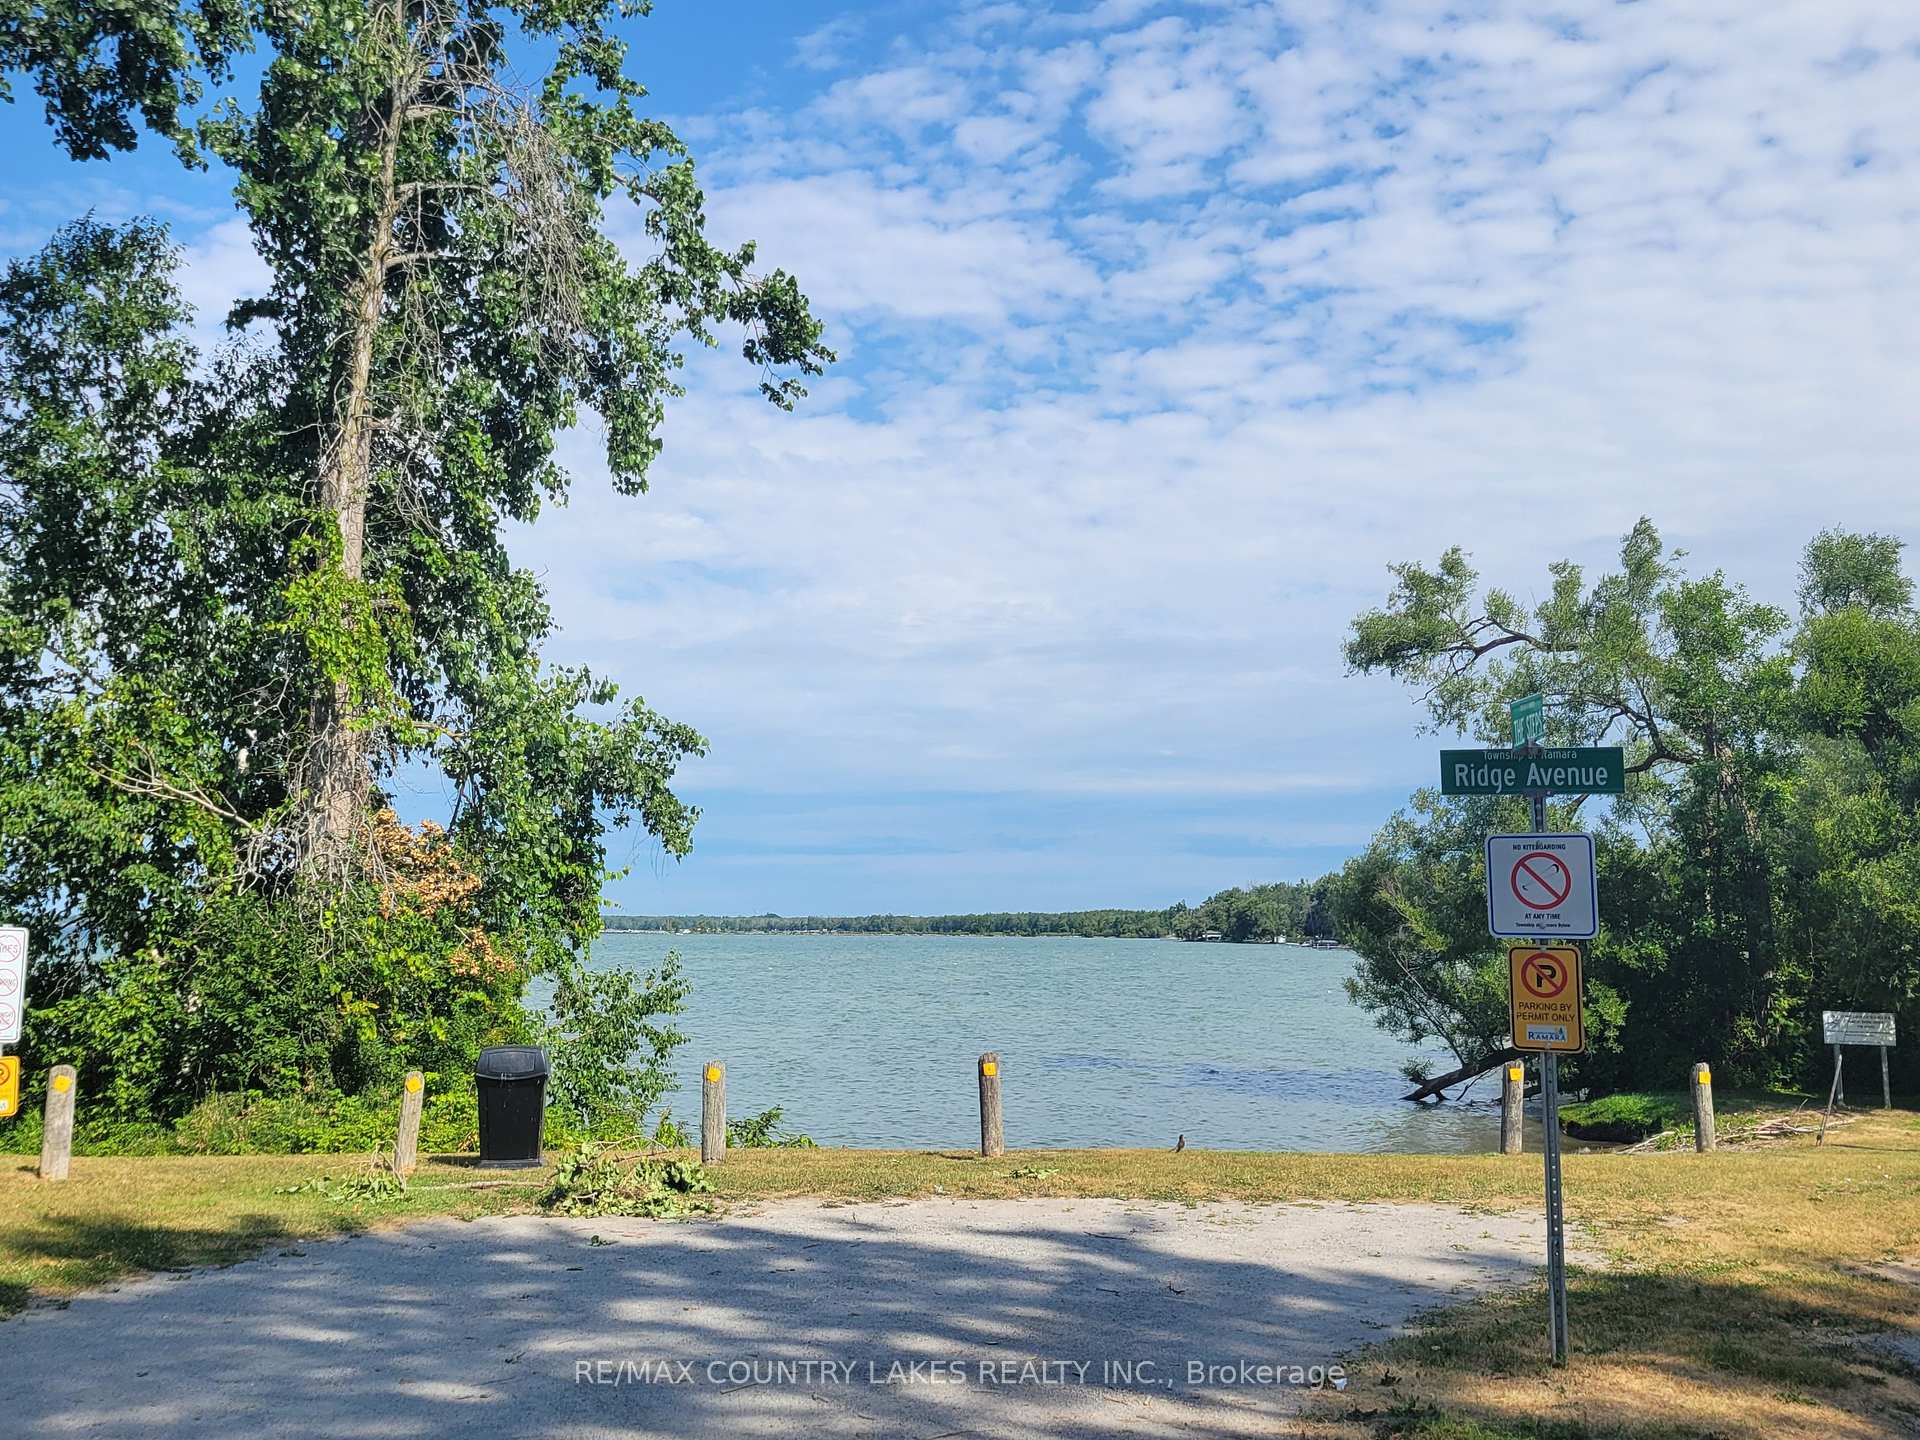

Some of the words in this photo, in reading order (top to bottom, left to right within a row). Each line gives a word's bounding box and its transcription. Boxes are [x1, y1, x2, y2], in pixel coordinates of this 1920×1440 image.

[1455, 763, 1516, 793] Ridge
[1526, 762, 1608, 786] Avenue
[1518, 1002, 1558, 1011] PARKING
[1560, 1003, 1572, 1012] BY
[1516, 1012, 1549, 1020] PERMIT
[1551, 1013, 1575, 1022] ONLY
